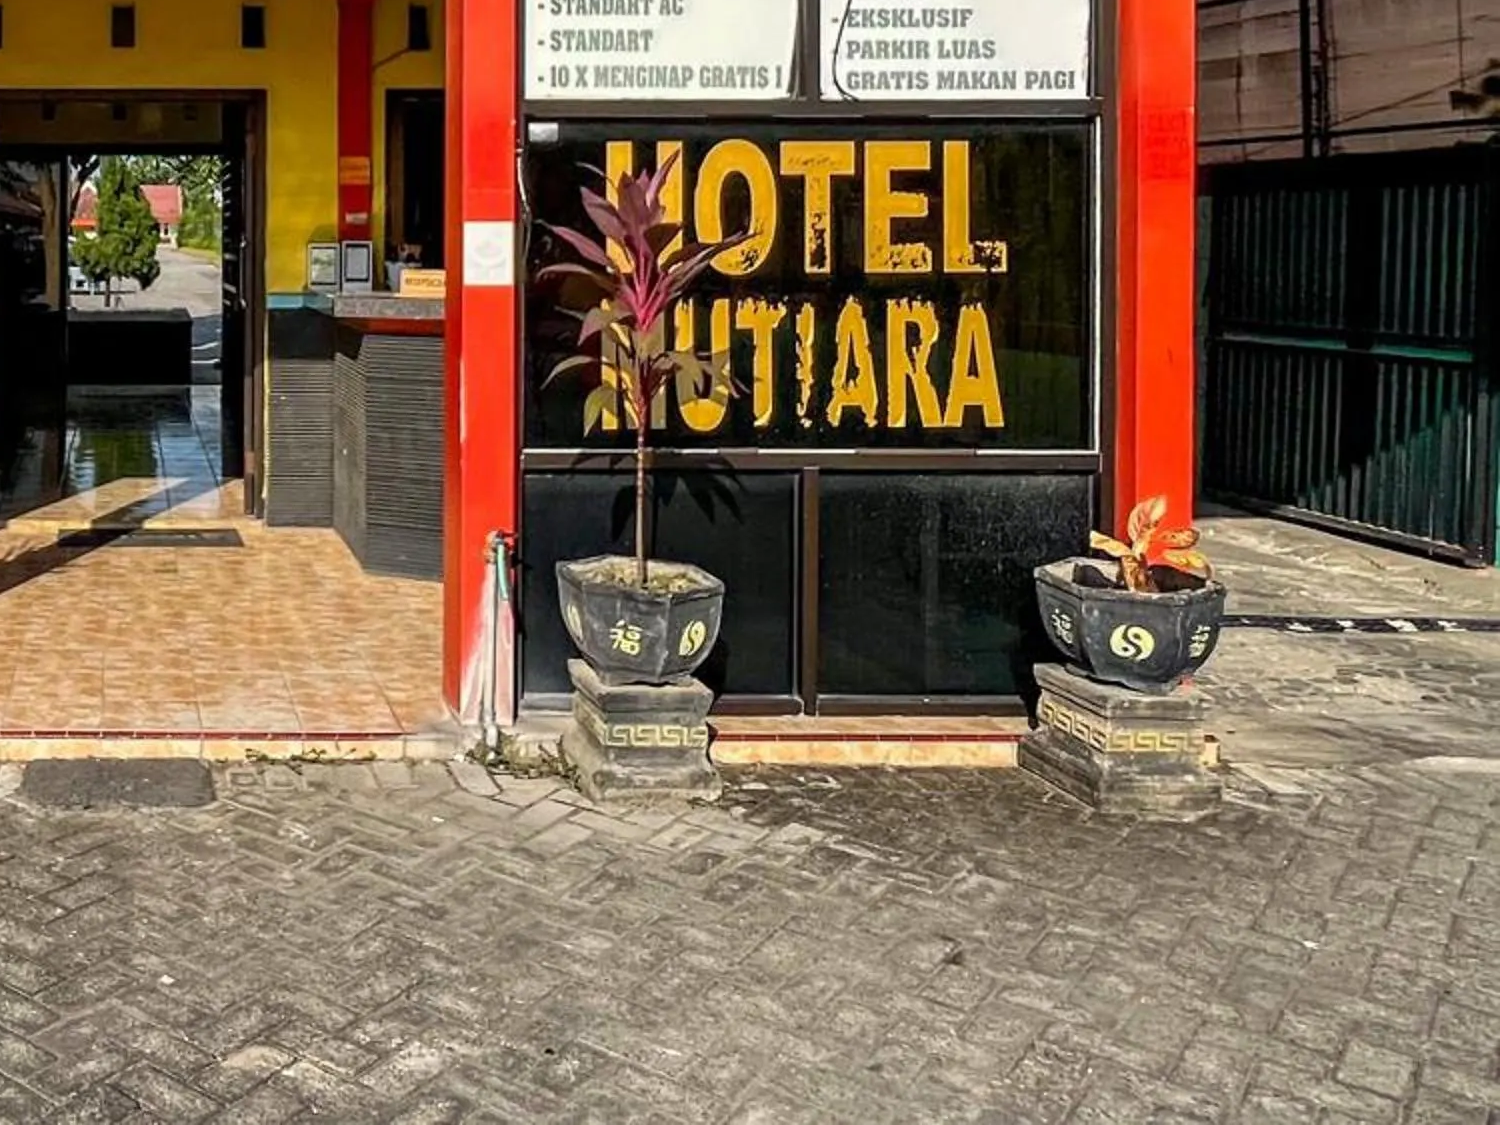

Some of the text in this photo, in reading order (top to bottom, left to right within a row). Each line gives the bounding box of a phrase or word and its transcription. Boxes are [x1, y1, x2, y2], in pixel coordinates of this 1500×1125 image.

[846, 9, 974, 29] EKSKLUSIF
[550, 29, 654, 53] STANDART
[846, 40, 997, 60] PARKIR LUAS
[550, 65, 570, 88] 10
[575, 65, 589, 88] X
[593, 65, 695, 89] MENGINAP
[699, 65, 770, 89] GRATIS
[846, 70, 1076, 91] GRATIS MAKAN PAGI
